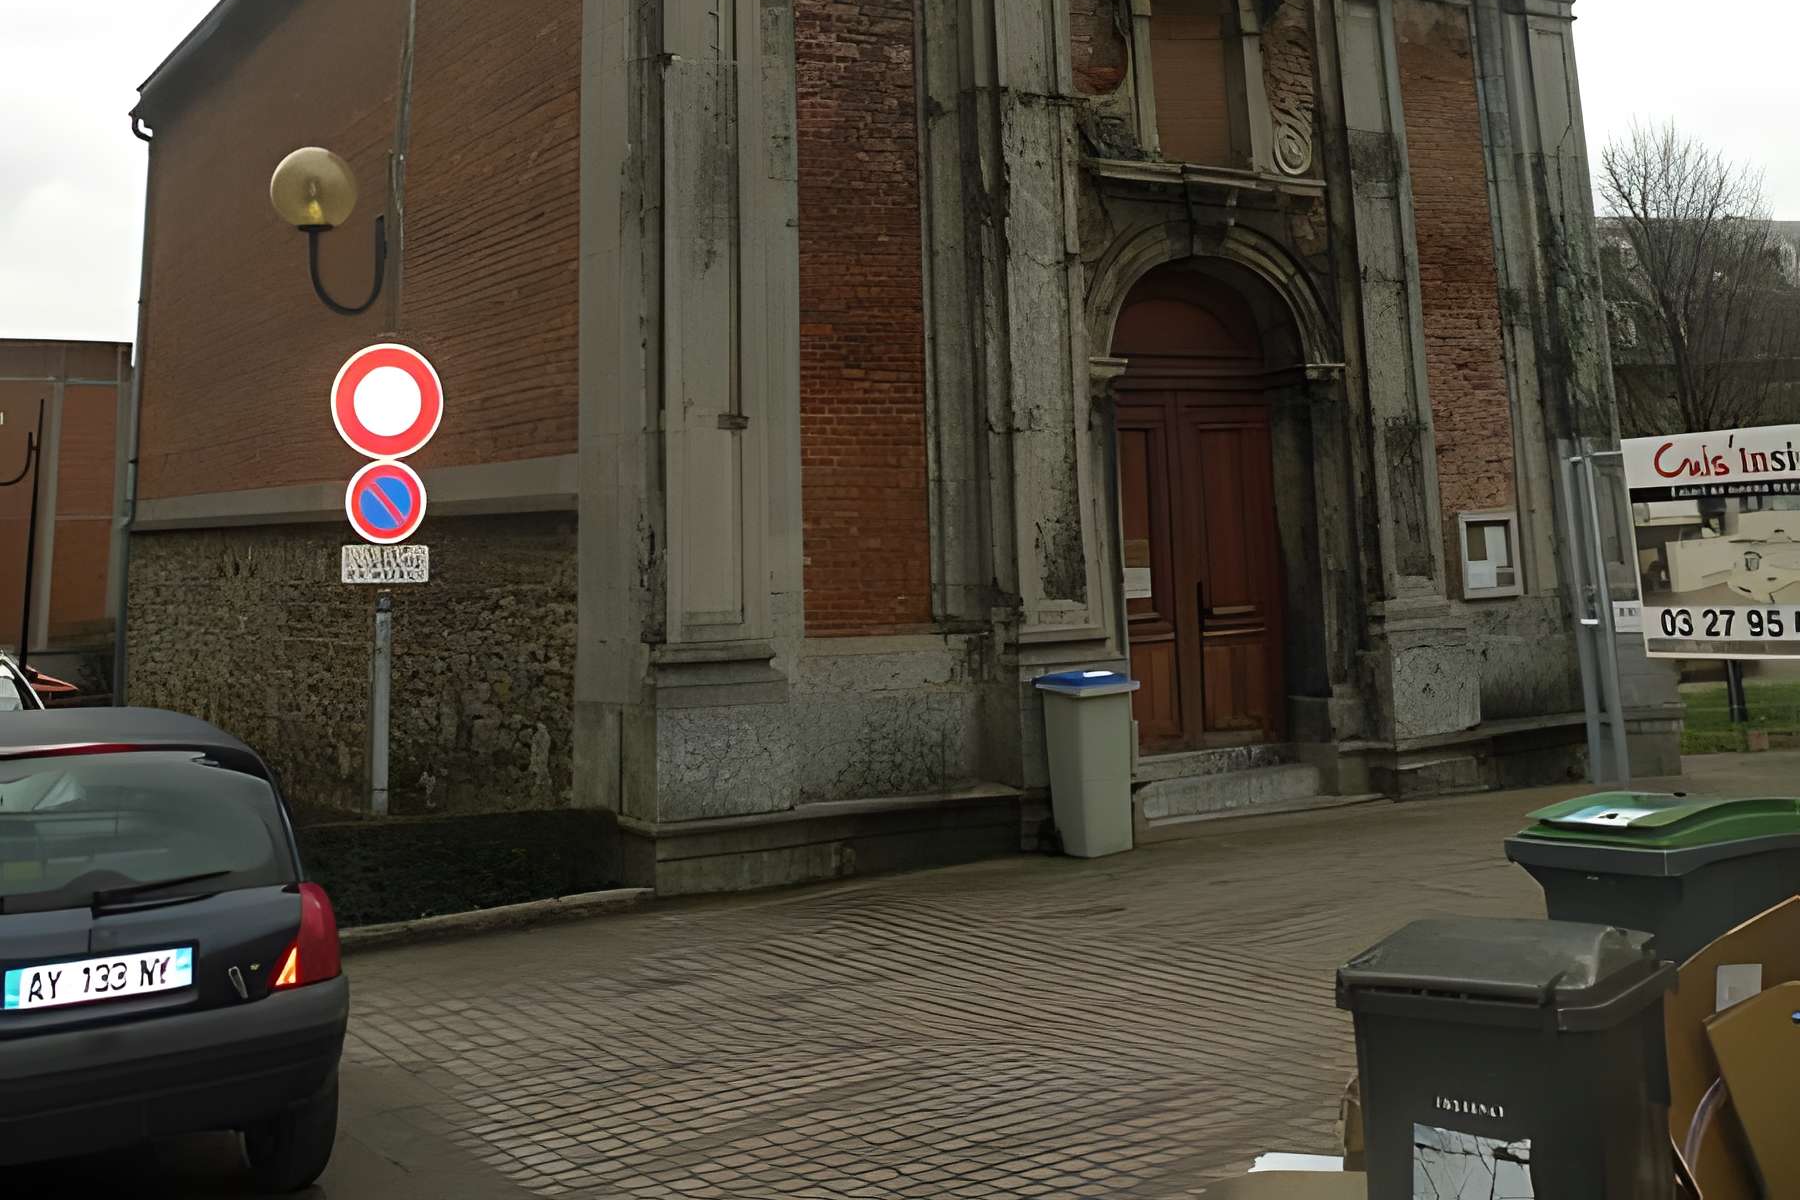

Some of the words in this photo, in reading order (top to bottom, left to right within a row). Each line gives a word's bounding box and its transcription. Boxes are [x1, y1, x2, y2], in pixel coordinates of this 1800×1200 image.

[1661, 609, 1693, 636] 03
[1702, 609, 1735, 636] 27
[1747, 610, 1784, 637] 95
[28, 970, 62, 1002] AY
[83, 962, 127, 993] 133
